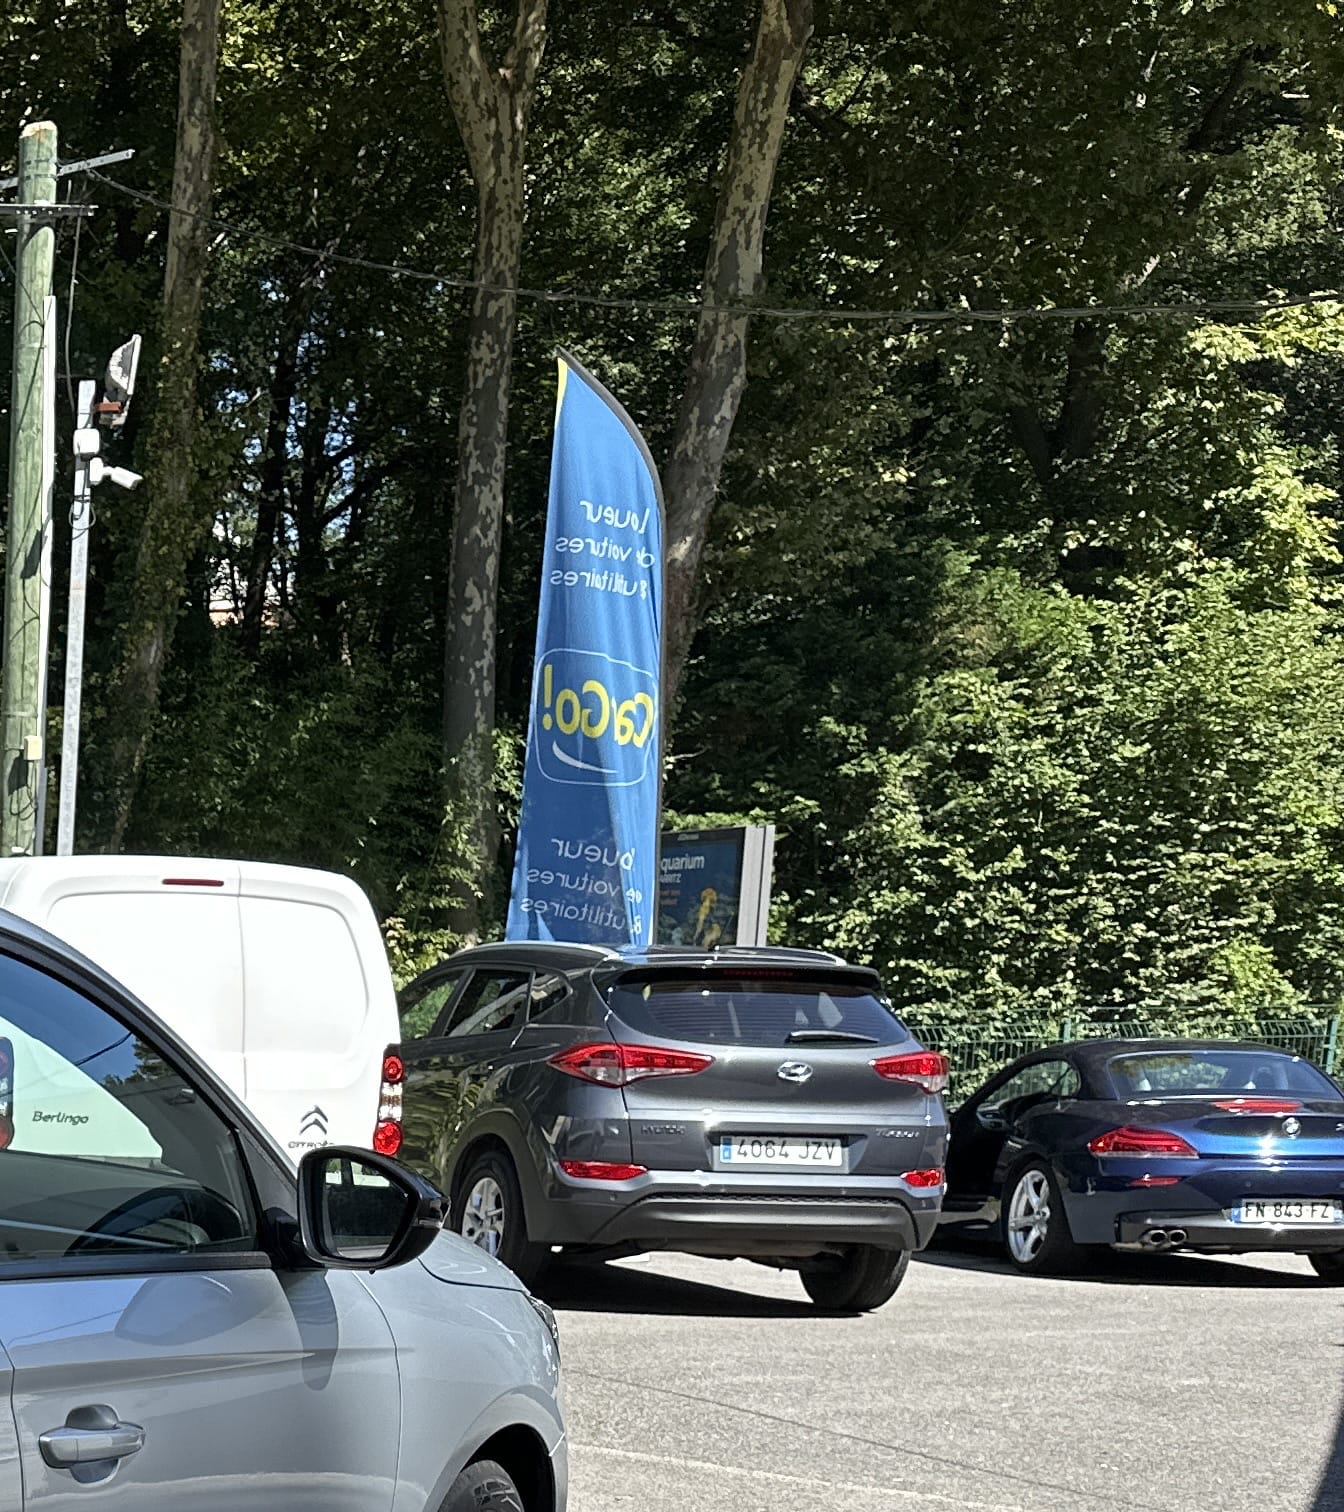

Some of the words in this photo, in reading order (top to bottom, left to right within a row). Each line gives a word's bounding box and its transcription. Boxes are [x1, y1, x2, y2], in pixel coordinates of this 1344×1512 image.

[660, 853, 705, 872] quarium
[32, 1111, 89, 1125] Berlingo
[799, 1140, 836, 1160] JZV
